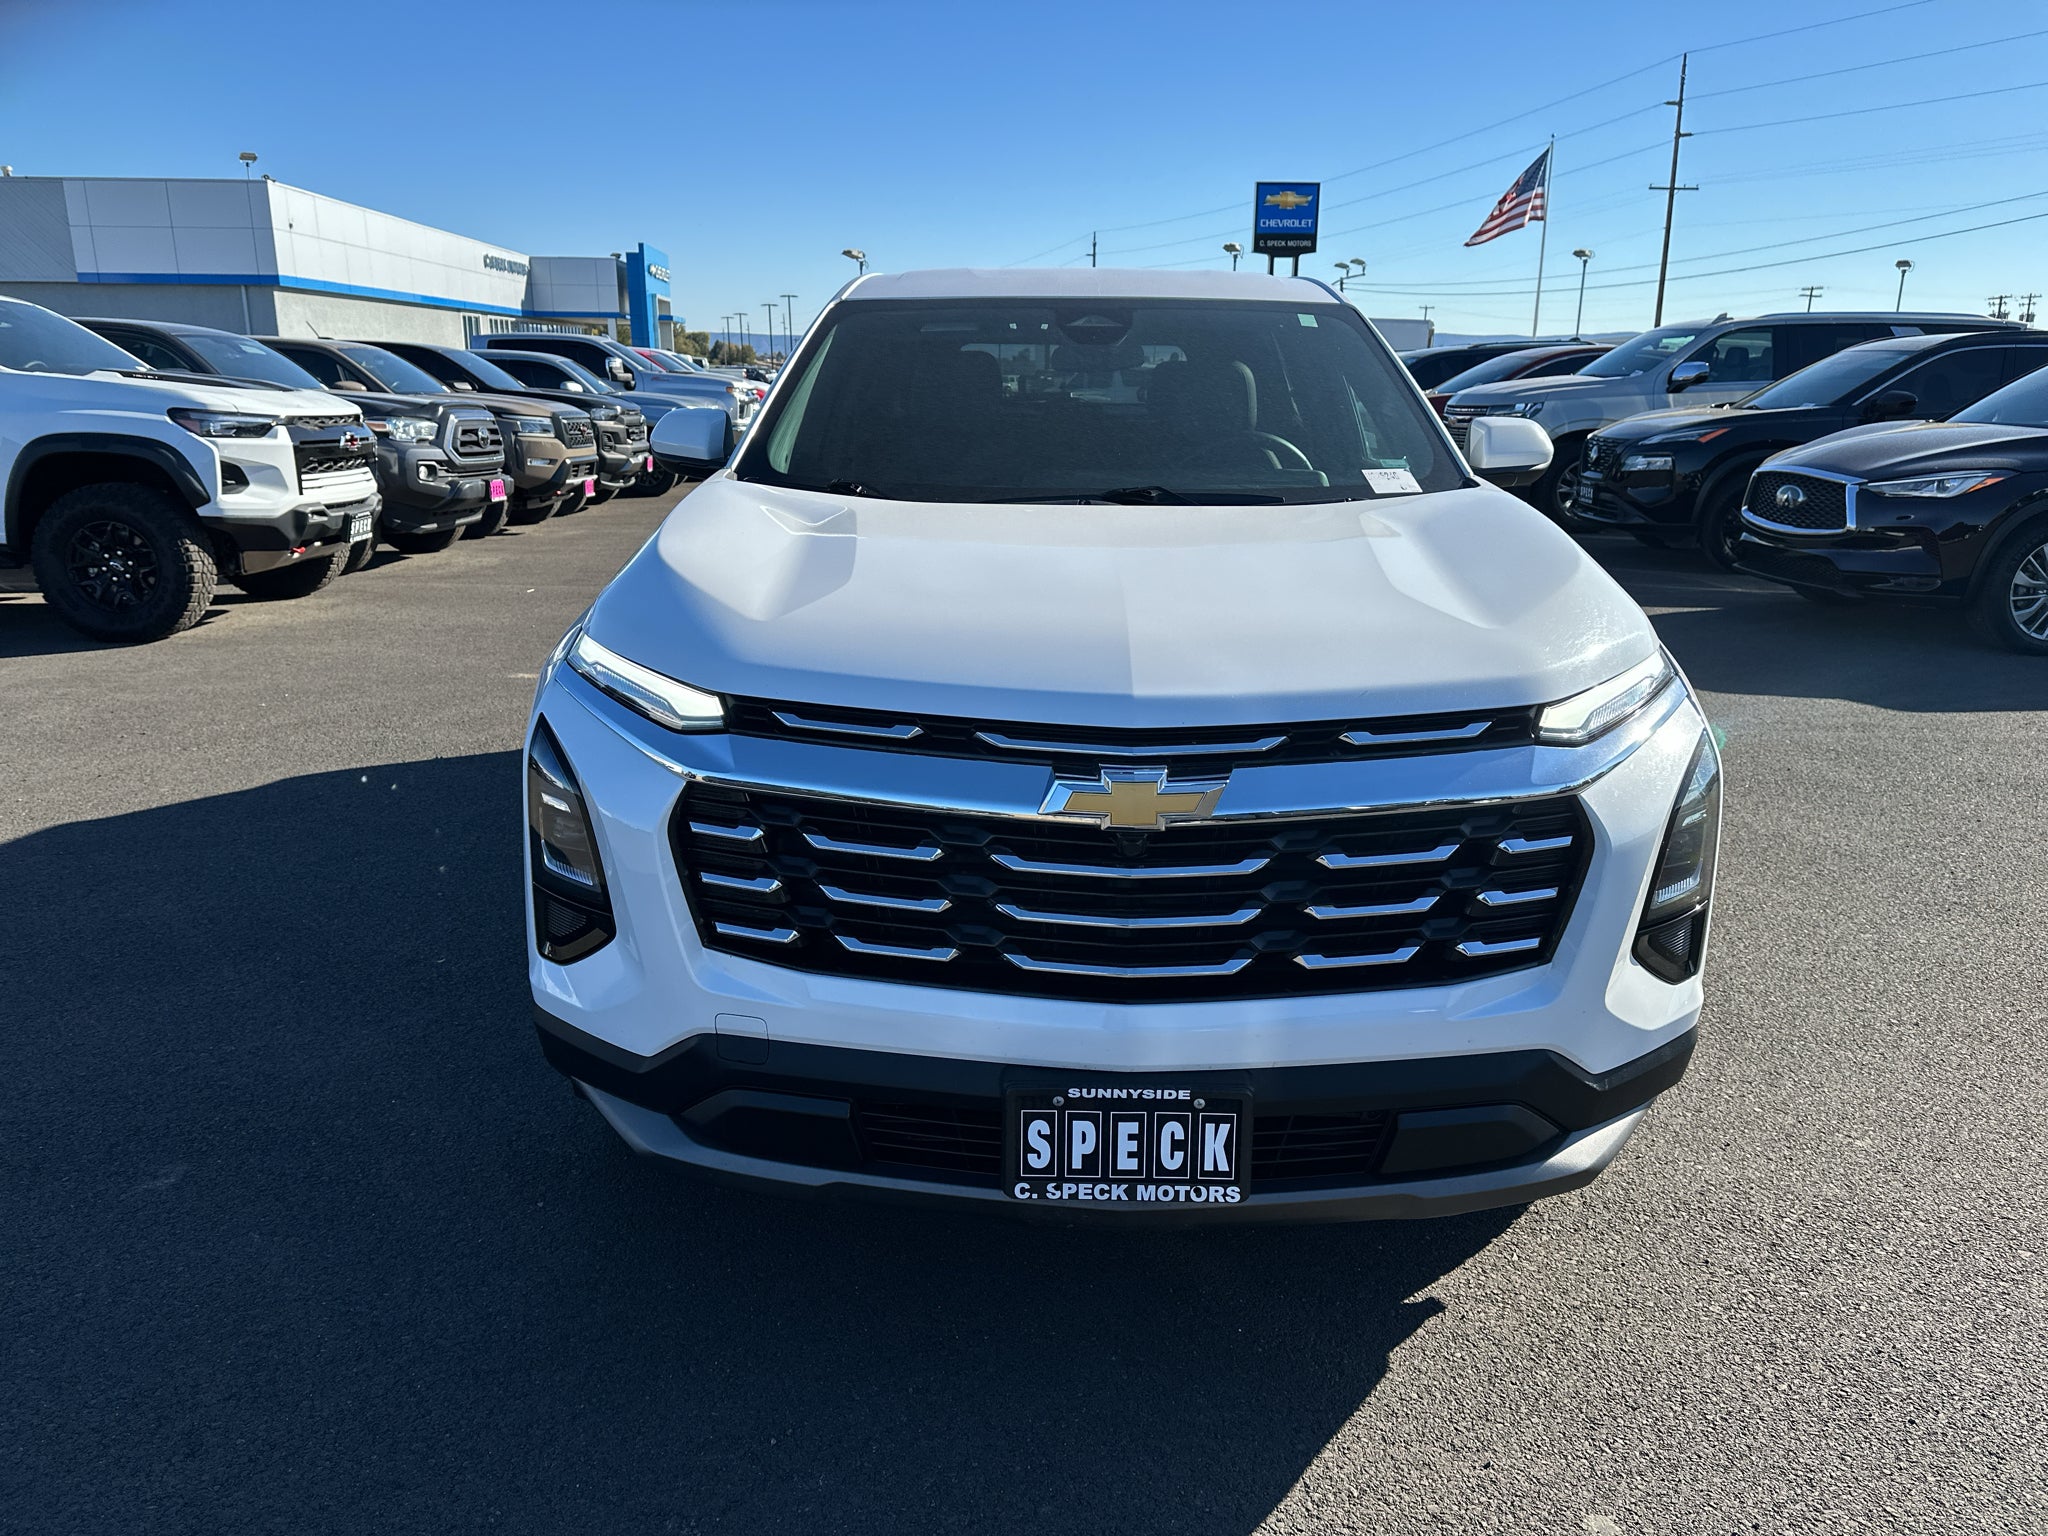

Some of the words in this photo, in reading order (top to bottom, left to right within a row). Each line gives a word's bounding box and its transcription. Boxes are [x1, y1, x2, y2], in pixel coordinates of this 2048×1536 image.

[1260, 218, 1314, 228] CHEVROLET
[1067, 1088, 1191, 1100] SUNNYSIDE
[1027, 1119, 1231, 1172] SPECK
[1014, 1183, 1038, 1199] C.
[1046, 1183, 1129, 1200] SPECK
[1136, 1185, 1241, 1203] MOTORS
